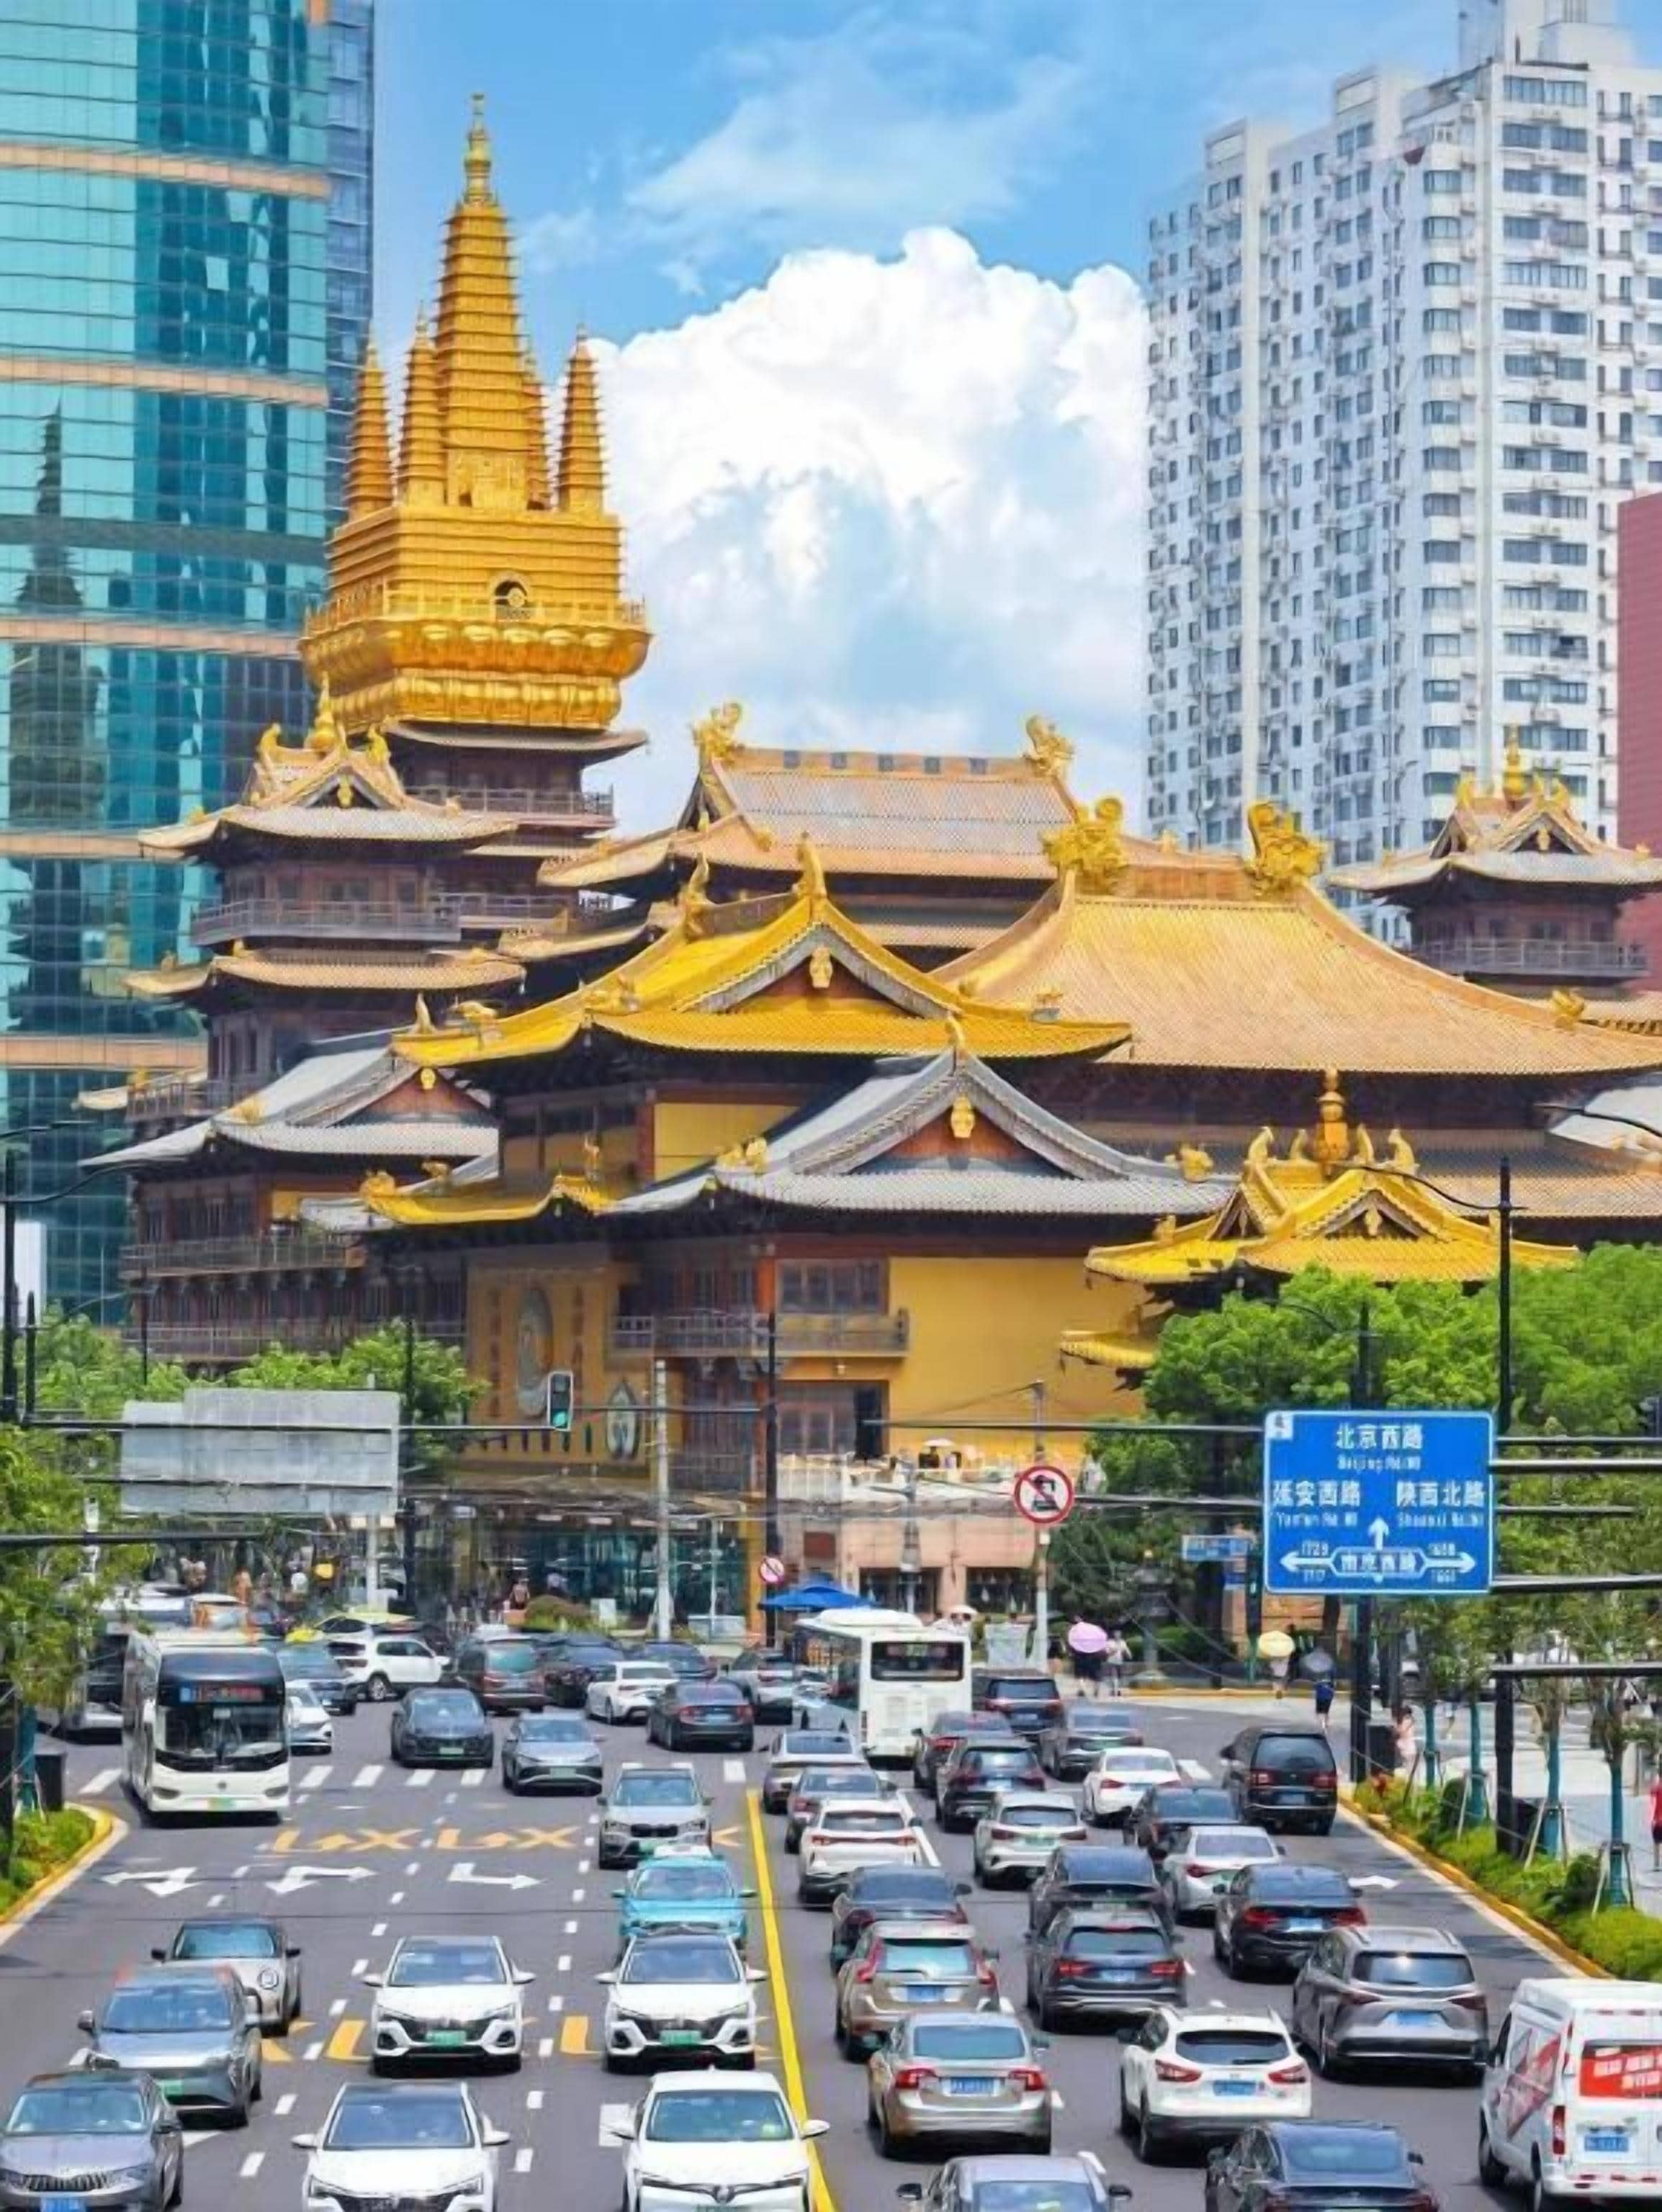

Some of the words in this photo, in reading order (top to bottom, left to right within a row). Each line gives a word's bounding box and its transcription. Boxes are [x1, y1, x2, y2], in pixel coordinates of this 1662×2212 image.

[1337, 1423, 1423, 1449] 北京西路
[1272, 1480, 1360, 1507] 延安西路
[1397, 1480, 1486, 1507] 陕西北路
[1341, 1552, 1416, 1573] 南京西路
